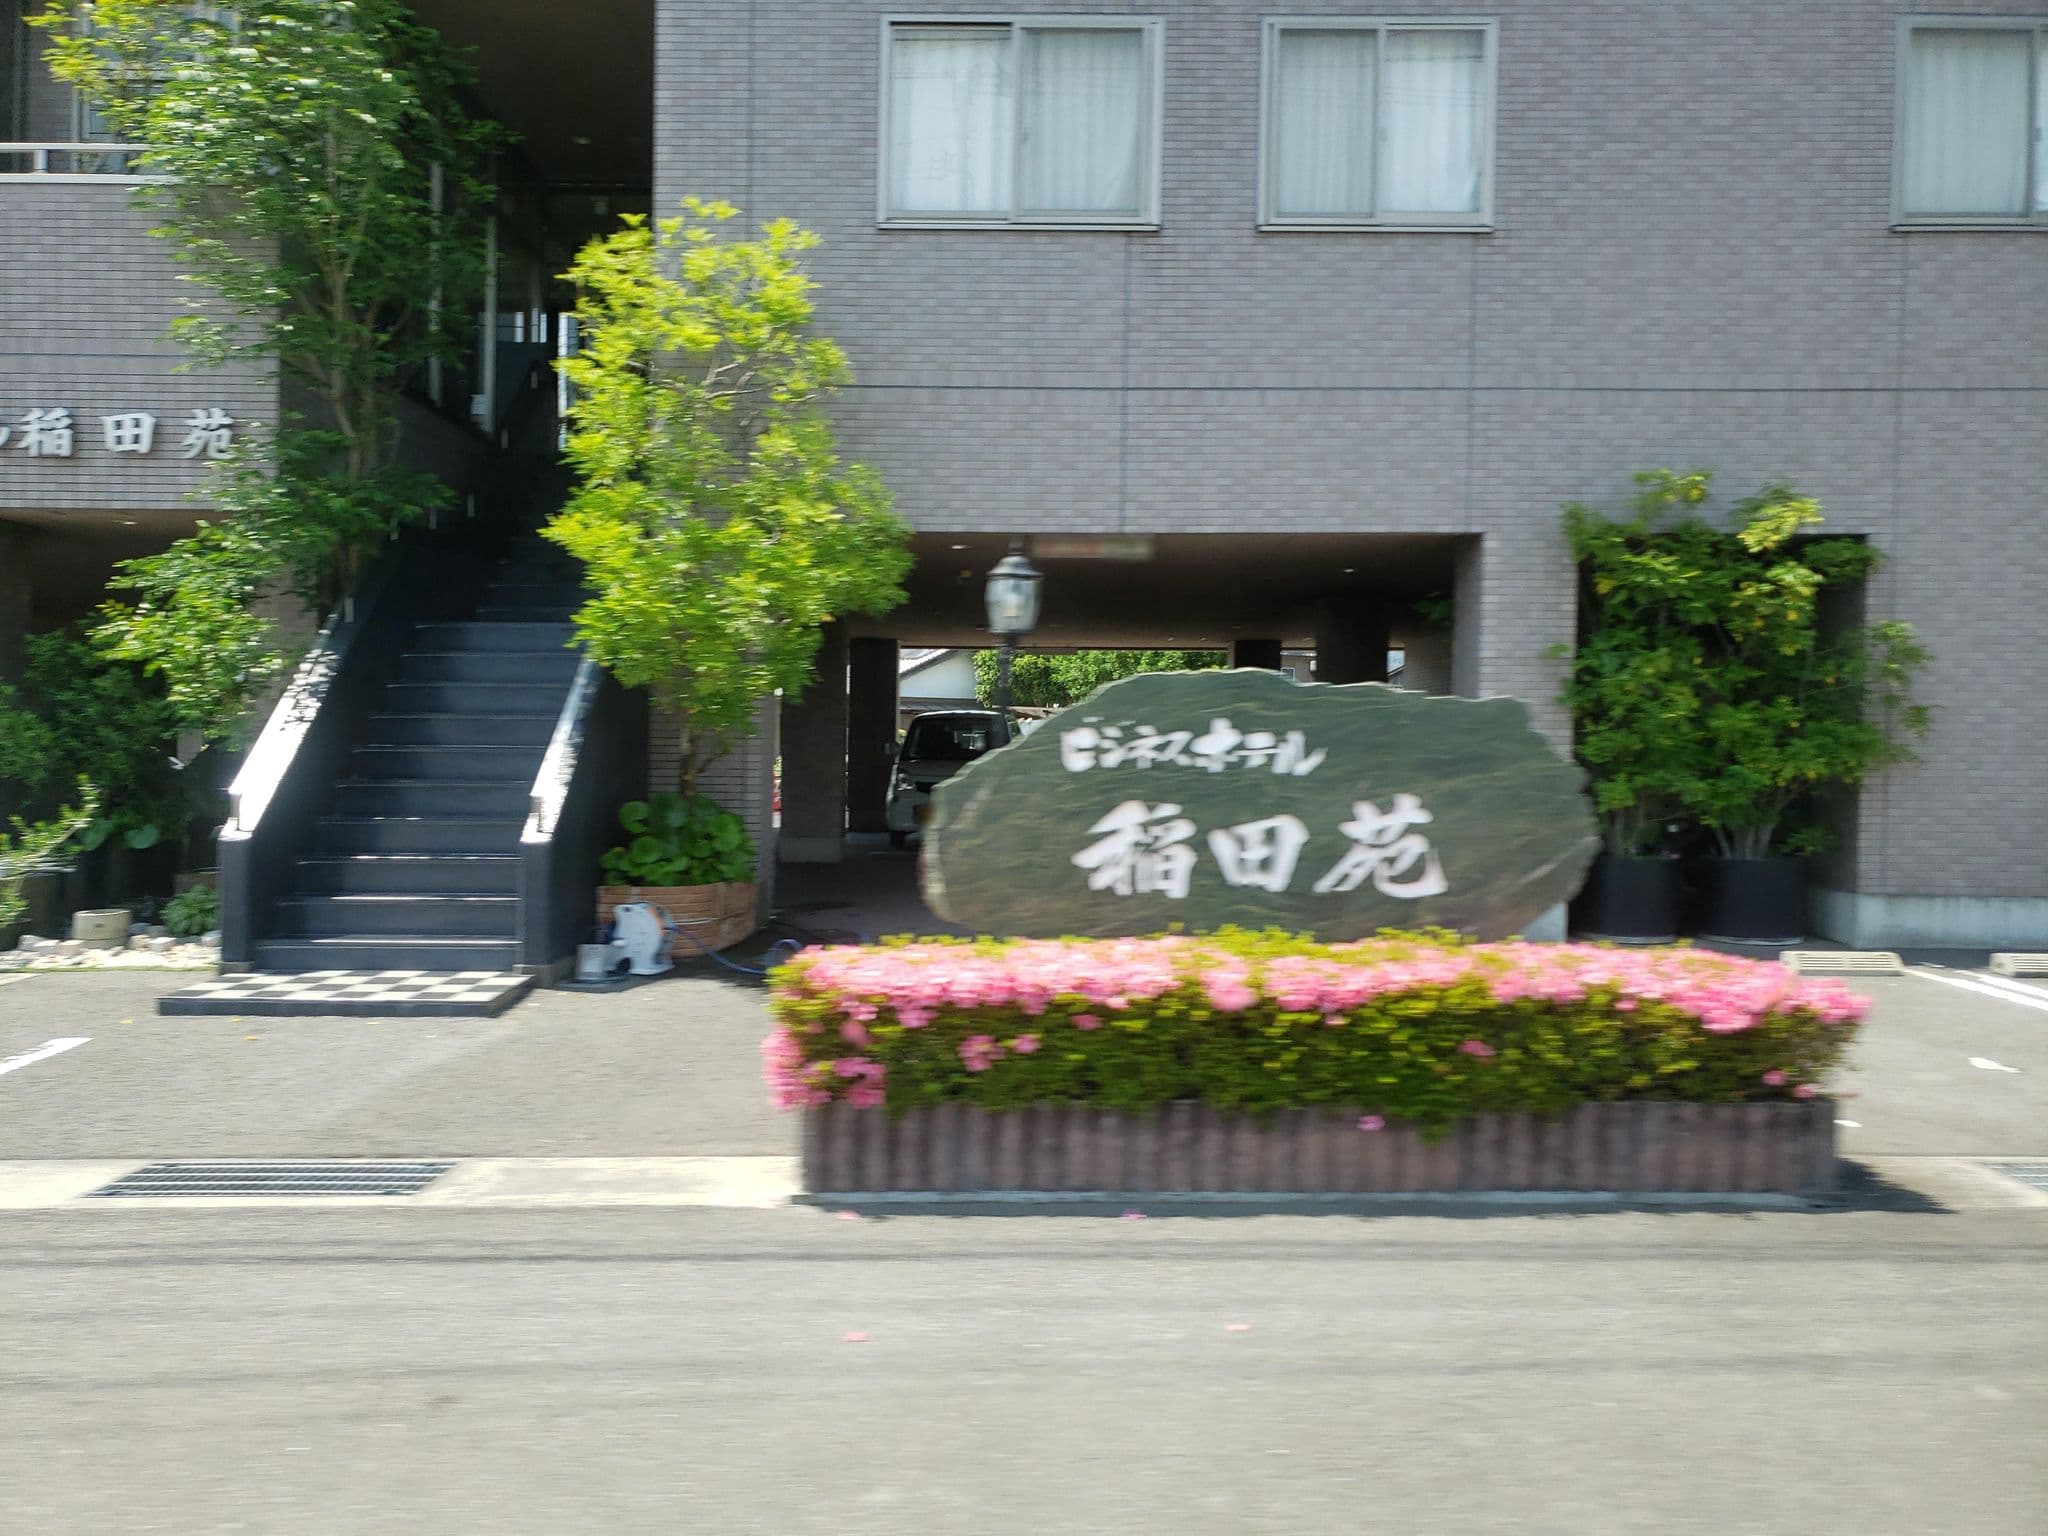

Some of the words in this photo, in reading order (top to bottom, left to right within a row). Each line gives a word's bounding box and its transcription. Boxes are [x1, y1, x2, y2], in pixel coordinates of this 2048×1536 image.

[0, 408, 235, 459] 稲田苑
[1060, 716, 1328, 776] ビジネスホテル
[1072, 793, 1449, 899] 稲田苑
